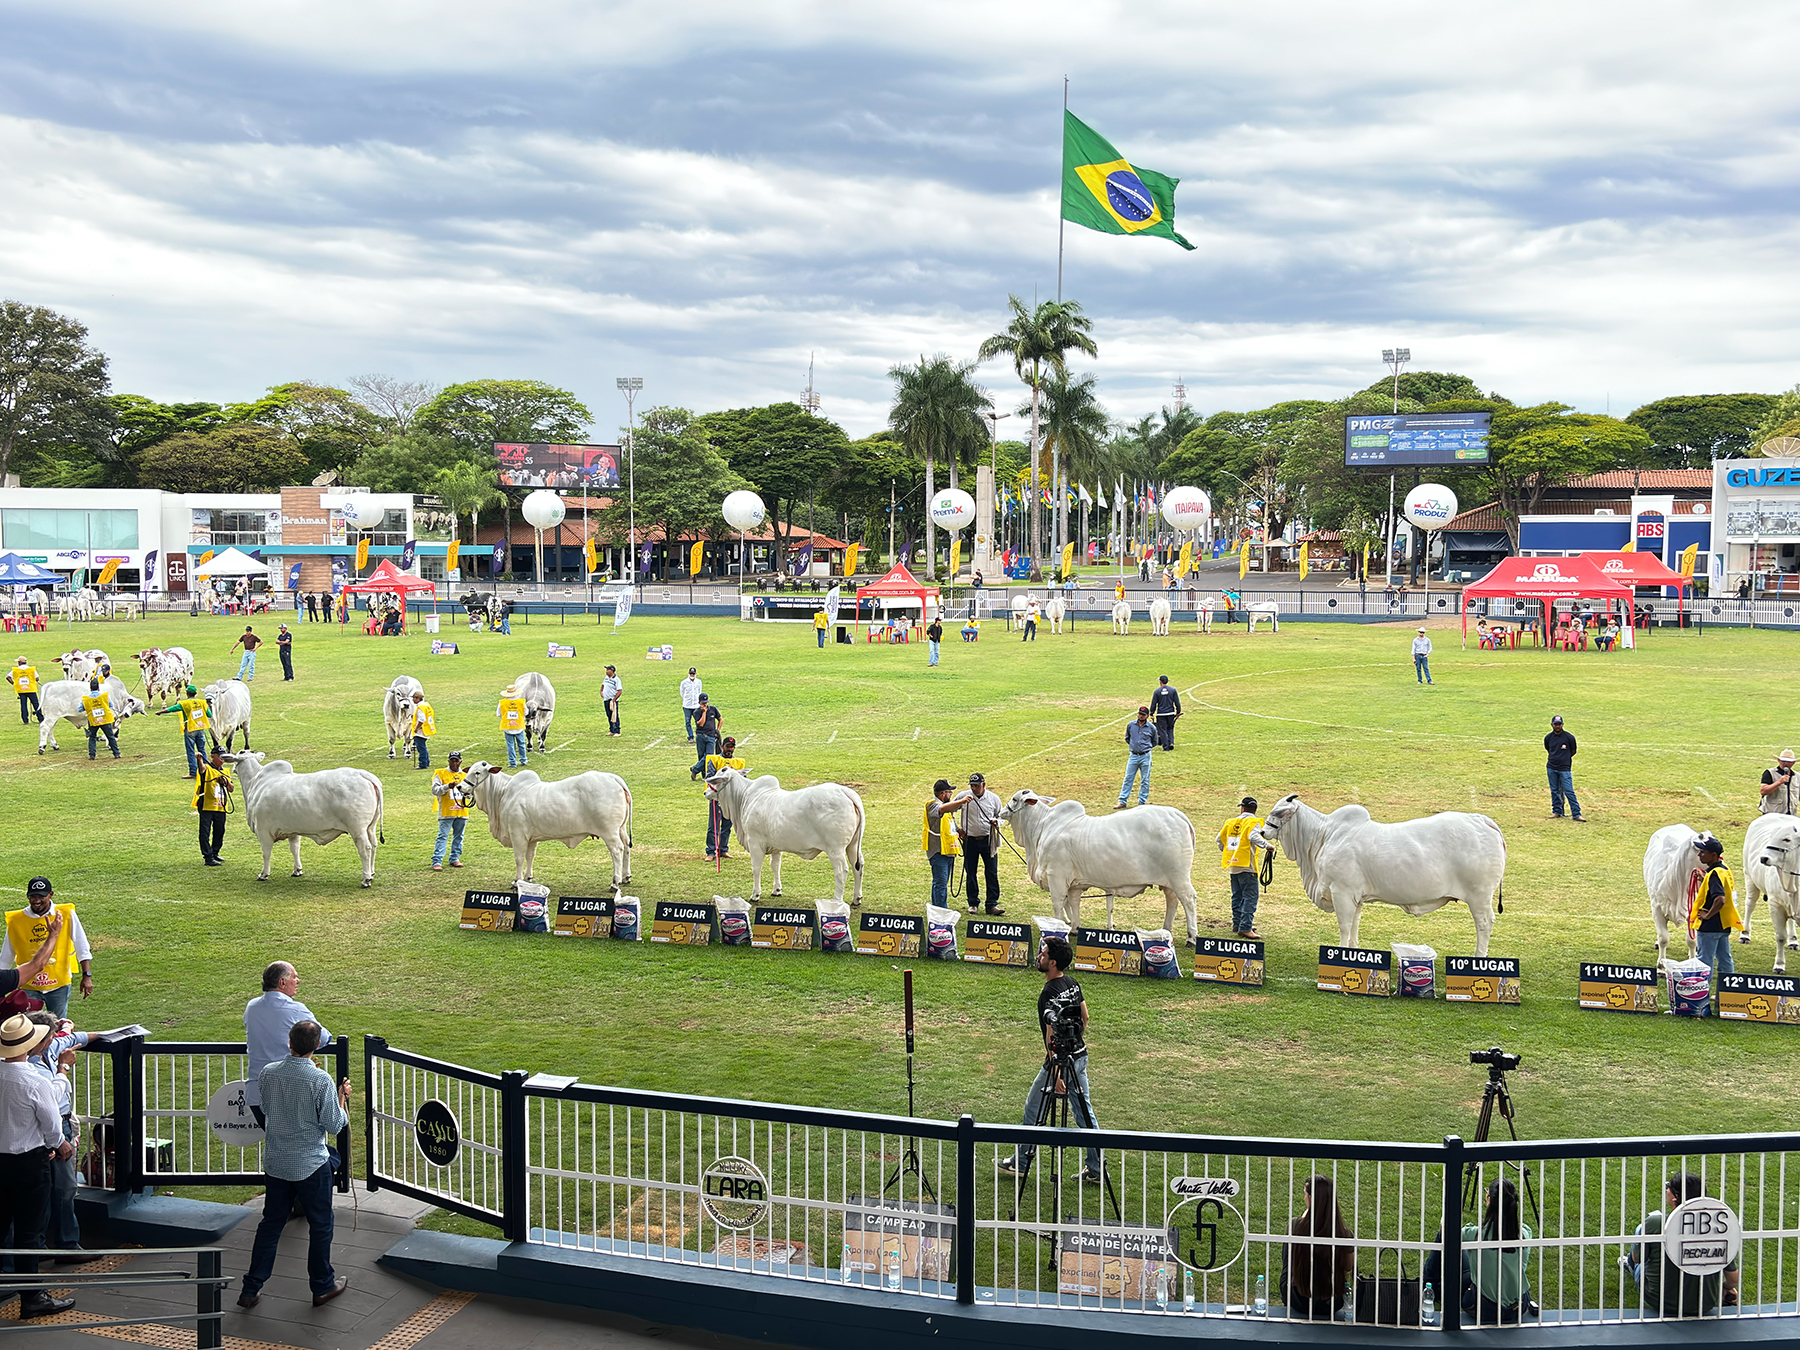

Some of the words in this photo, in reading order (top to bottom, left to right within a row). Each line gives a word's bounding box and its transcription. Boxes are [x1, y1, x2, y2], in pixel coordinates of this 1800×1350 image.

[1175, 502, 1204, 514] ITAIPAVA
[1413, 508, 1448, 518] PRODUZ
[282, 515, 328, 525] Brahman
[1637, 523, 1664, 538] ABS
[1515, 575, 1579, 583] MATSUDA
[480, 894, 511, 906] LUGAR
[574, 901, 607, 912] LUGAR
[673, 908, 706, 919] LUGAR
[772, 912, 807, 924] LUGAR
[879, 918, 915, 930] LUGAR
[986, 924, 1022, 937] LUGAR
[1098, 933, 1136, 945] LUGAR
[1217, 941, 1257, 955] LUGAR
[1341, 950, 1383, 964] LUGAR
[1472, 959, 1515, 972] LUGAR
[1607, 966, 1652, 981] LUGAR
[1747, 977, 1795, 992] LUGAR
[429, 1145, 447, 1157] 1880
[707, 1175, 763, 1201] LARA
[1207, 1180, 1235, 1196] Velha
[1682, 1211, 1729, 1235] ABS
[1071, 1236, 1120, 1250] GRANDE
[1683, 1247, 1726, 1259] PECPLAN
